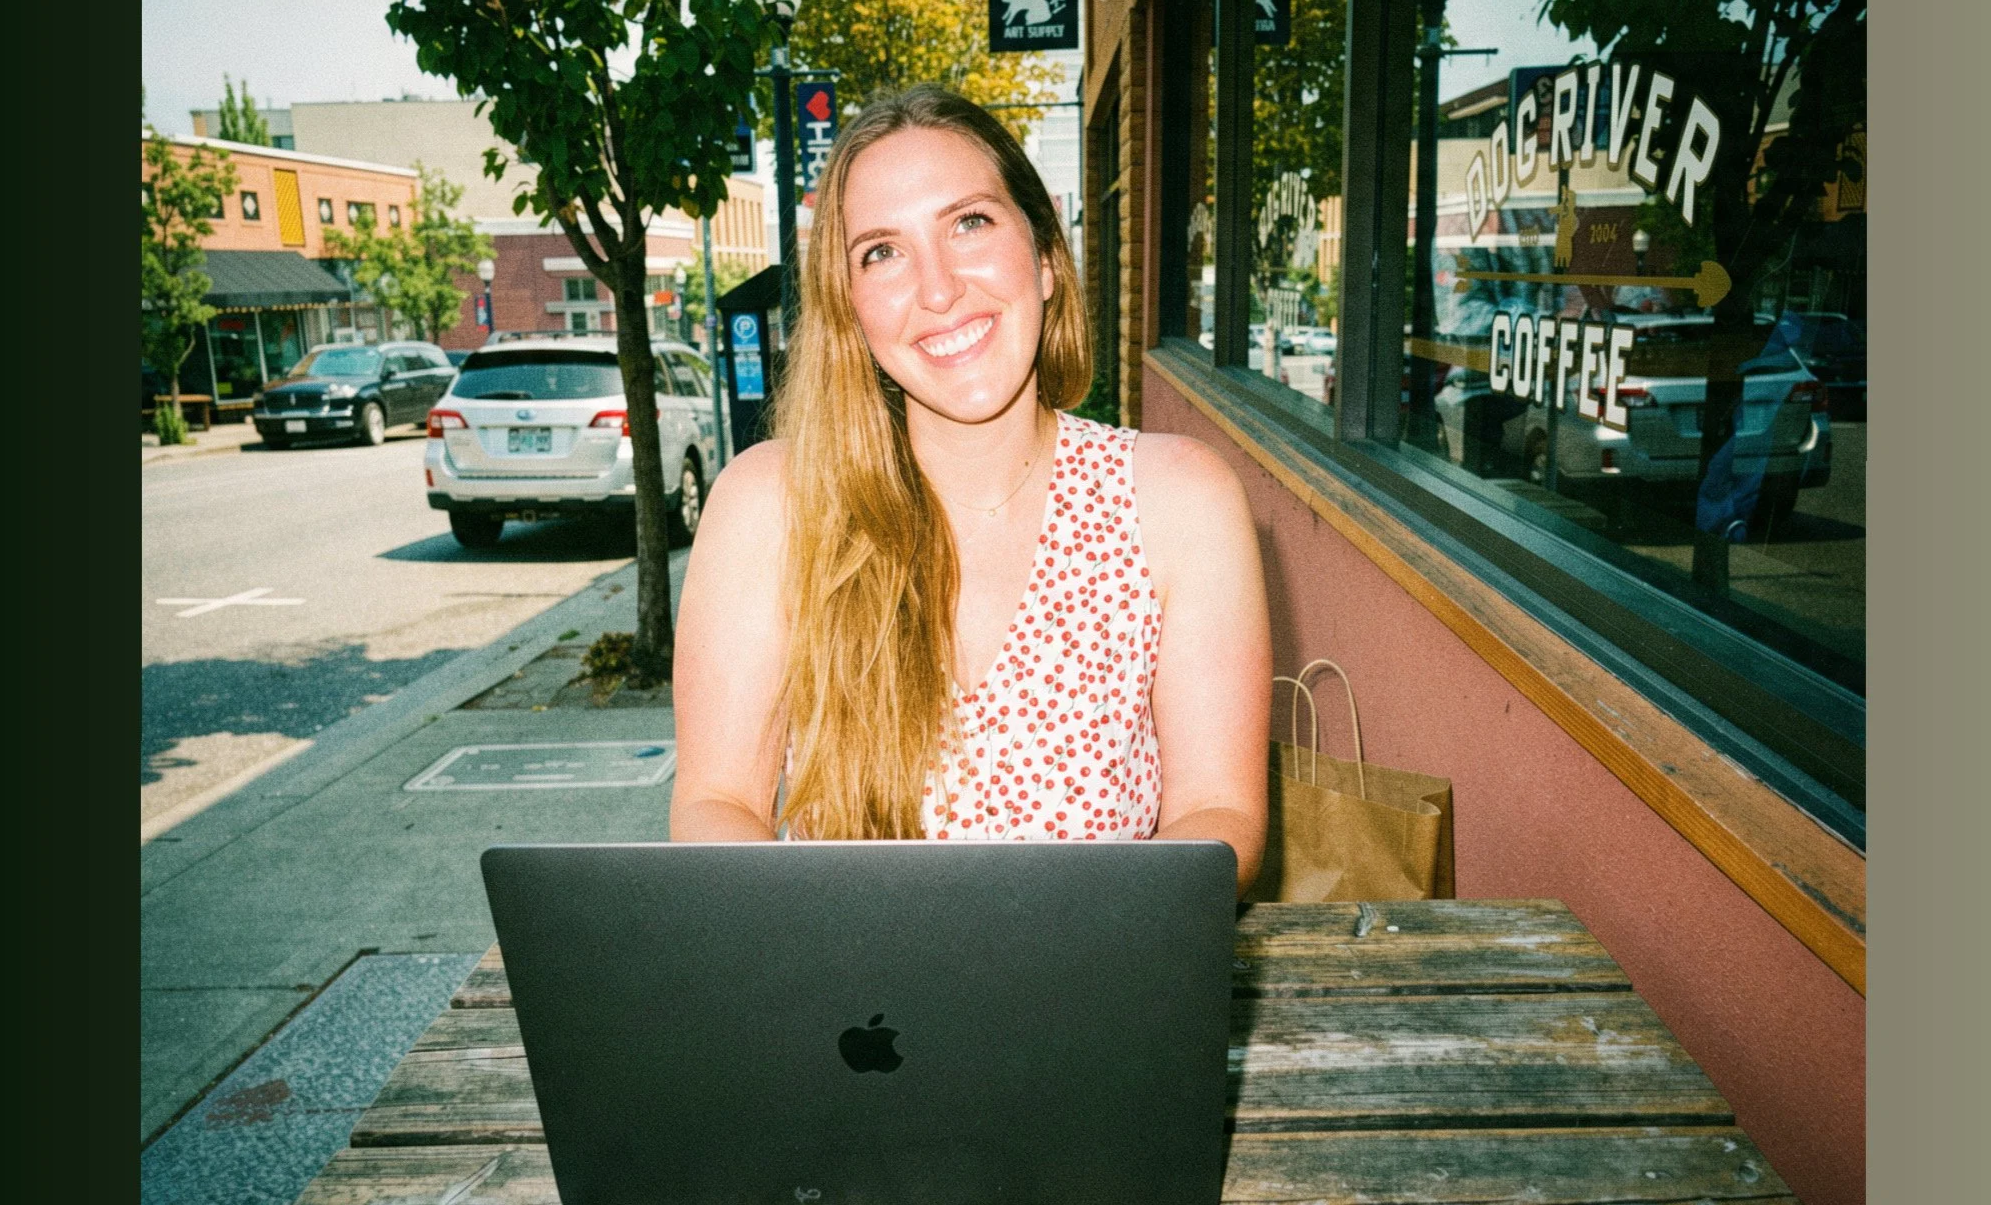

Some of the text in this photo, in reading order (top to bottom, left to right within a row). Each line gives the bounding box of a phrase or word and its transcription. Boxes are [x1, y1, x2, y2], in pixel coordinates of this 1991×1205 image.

[1003, 25, 1065, 39] ART SUPPLY
[1466, 59, 1721, 244] DOG RIVER
[1489, 310, 1635, 432] COFFEE
